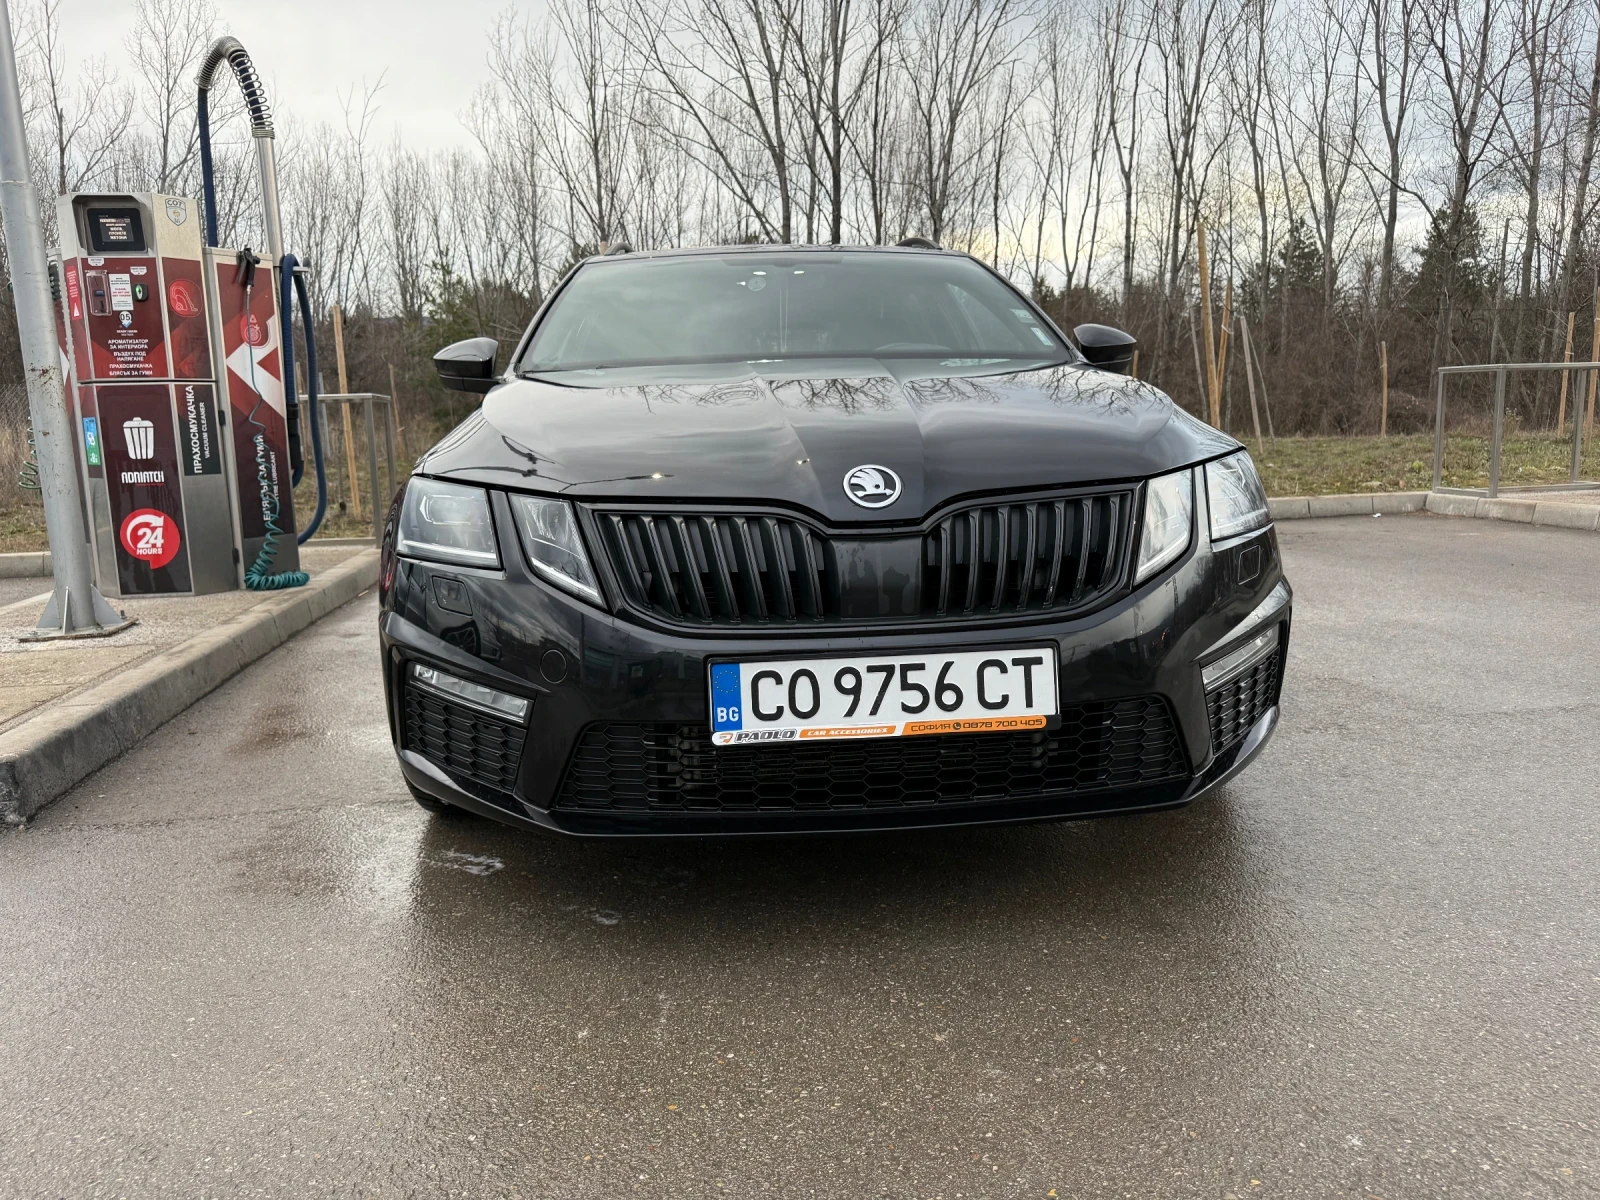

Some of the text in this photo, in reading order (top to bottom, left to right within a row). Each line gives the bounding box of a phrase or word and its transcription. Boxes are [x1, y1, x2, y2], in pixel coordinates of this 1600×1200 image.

[120, 313, 131, 321] 05
[200, 402, 208, 432] CLEANER
[185, 385, 203, 474] ПРАХОСМУКАЧКА
[270, 451, 278, 484] LUBRICANT
[136, 527, 165, 548] 24
[136, 547, 163, 555] HOURS
[751, 656, 1044, 721] CO 9756 CT
[716, 706, 739, 723] BG
[911, 723, 951, 732] СОФИЯ
[962, 718, 1043, 729] 0878 700 405
[735, 729, 797, 743] PAOLO
[828, 727, 889, 736] ACCESSORIES
